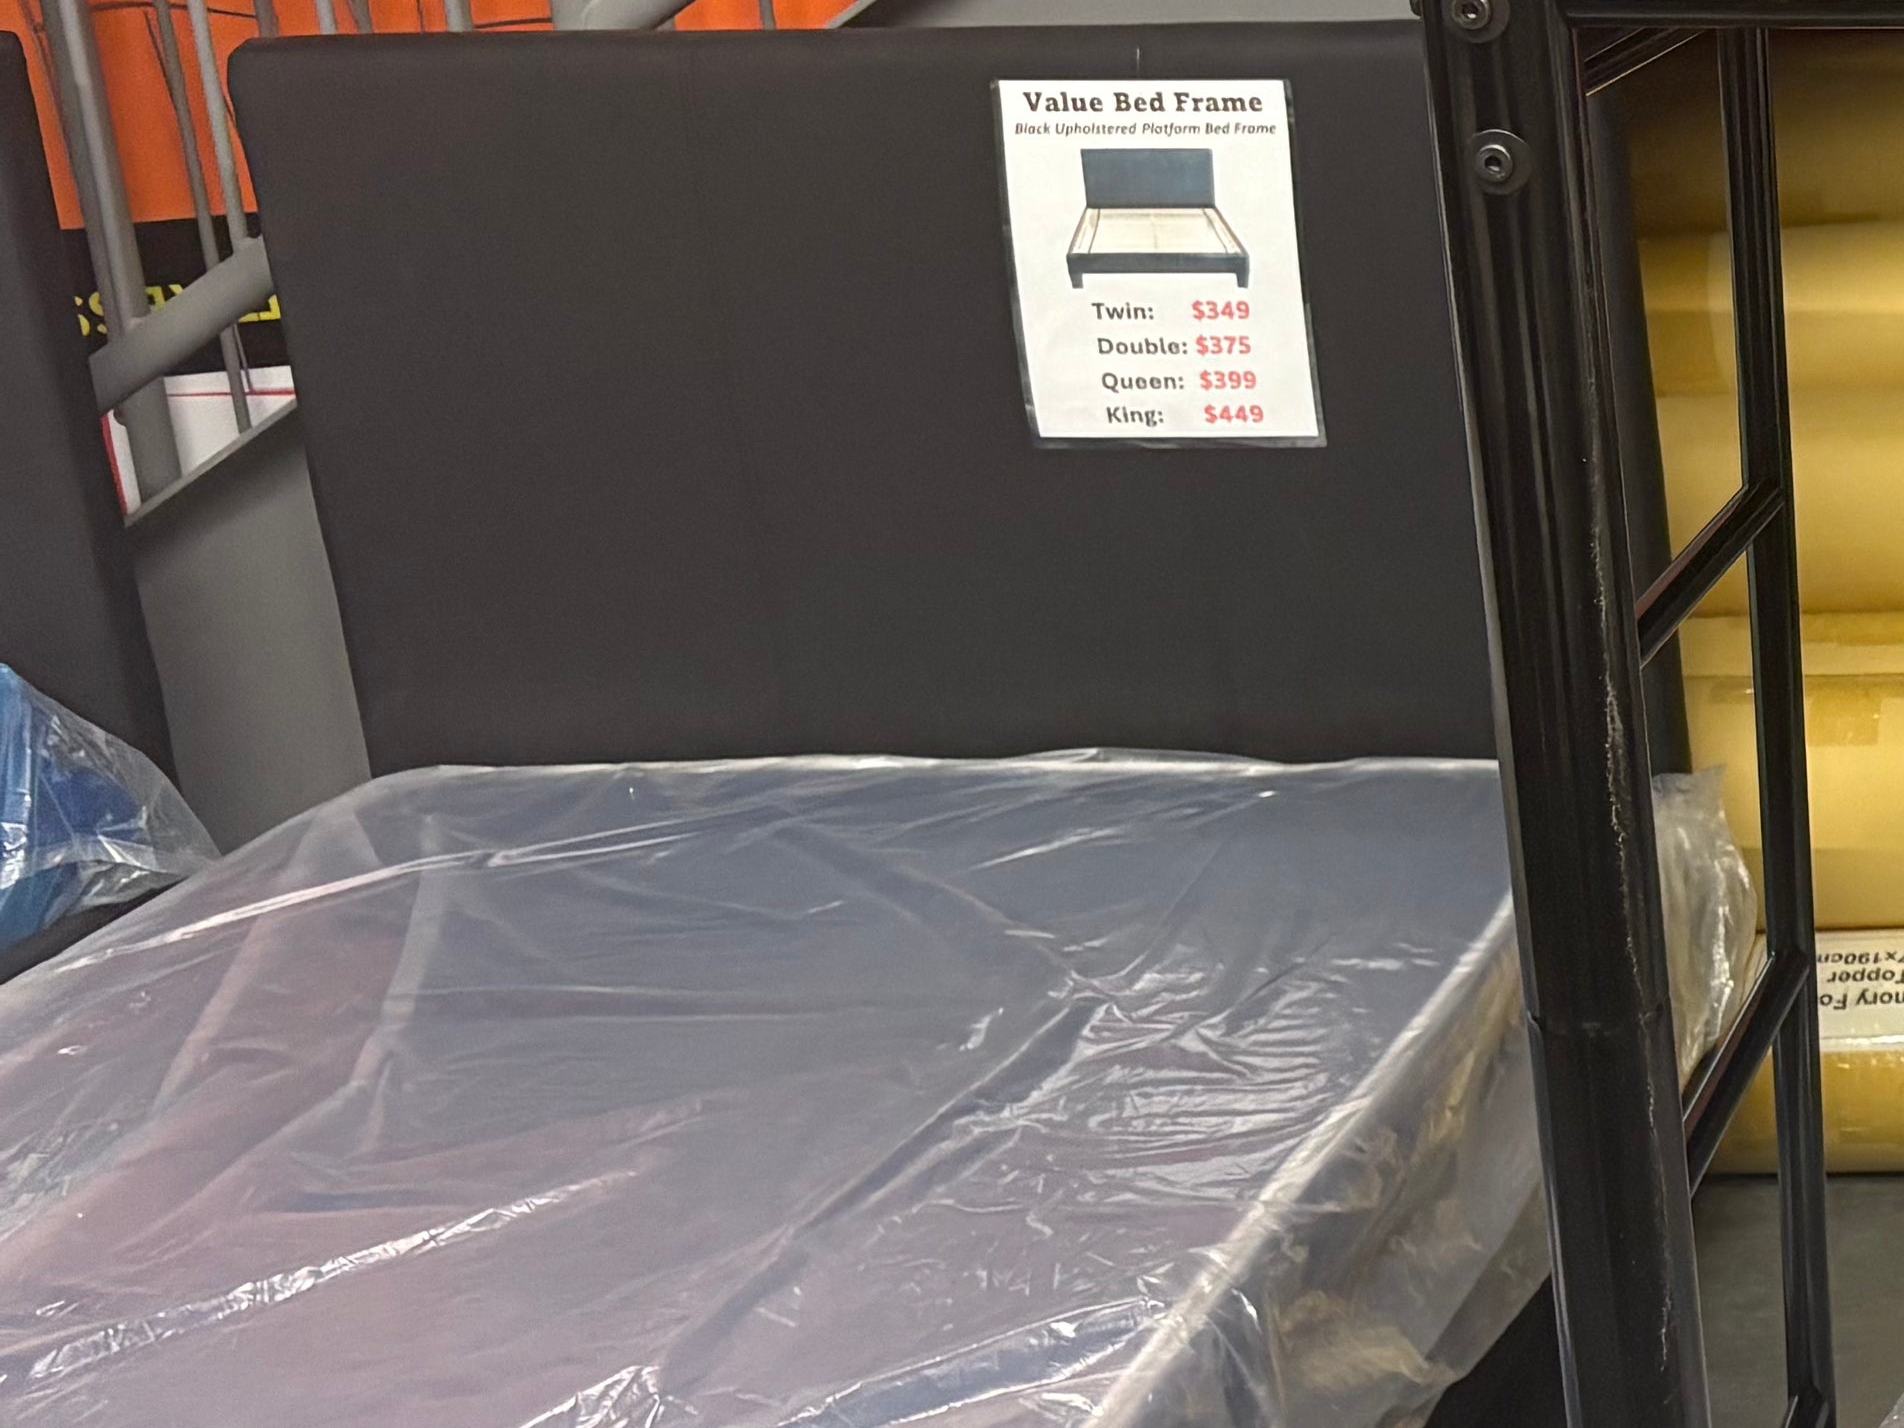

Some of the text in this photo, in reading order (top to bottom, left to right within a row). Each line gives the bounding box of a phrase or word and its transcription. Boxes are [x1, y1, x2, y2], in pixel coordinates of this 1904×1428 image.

[1023, 91, 1263, 113] Value Bed Frame
[1015, 122, 1277, 137] Black Upholstered Platform Bed Frame
[1091, 300, 1250, 321] Twin: $349
[1097, 335, 1251, 356] Double: $375
[1101, 370, 1257, 391] Queen: $399
[1106, 404, 1264, 428] King: $449
[1819, 993, 1848, 1010] Fo
